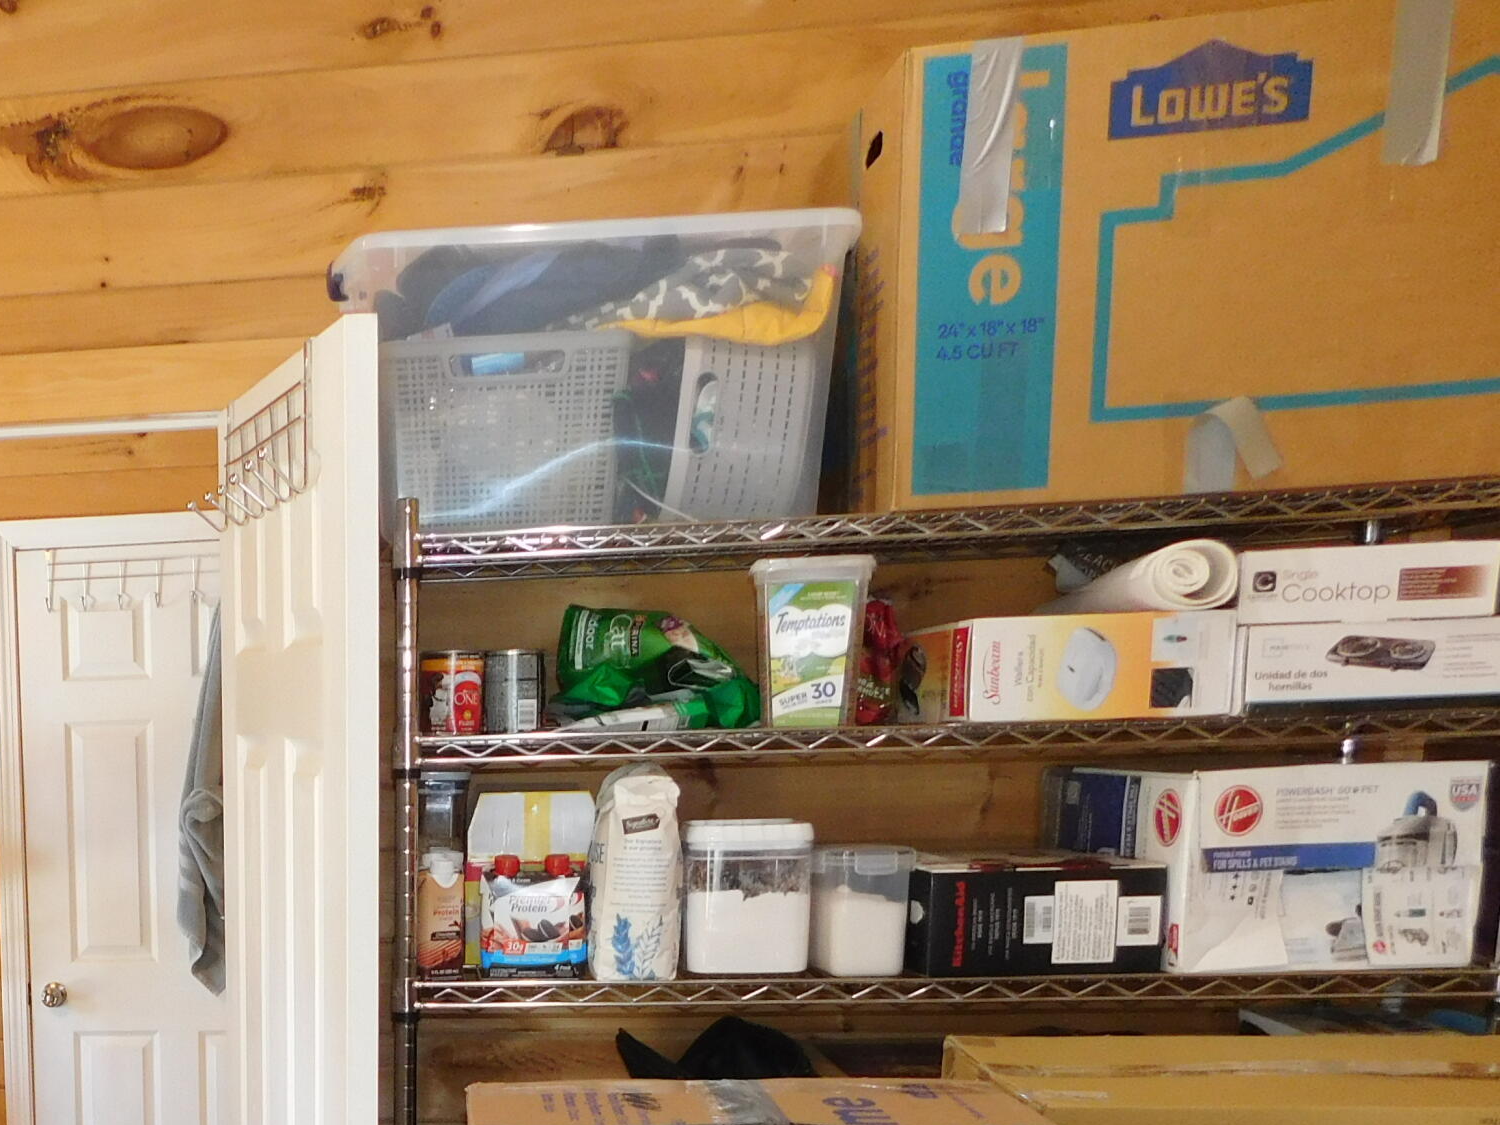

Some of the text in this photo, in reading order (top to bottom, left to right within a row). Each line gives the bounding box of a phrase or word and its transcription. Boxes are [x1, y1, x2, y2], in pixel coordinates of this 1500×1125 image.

[1130, 72, 1290, 127] LOWE'S
[937, 341, 1019, 361] 4.5 CU FT
[1282, 582, 1391, 604] Cooktop
[776, 611, 846, 635] Temptations
[982, 640, 1001, 706] Sunbeam
[1255, 670, 1328, 681] Unidad de dos
[811, 681, 836, 700] 30
[1268, 681, 1312, 692] hornillas
[455, 691, 480, 706] ONE
[1450, 783, 1479, 796] USA
[510, 902, 548, 913] Protein
